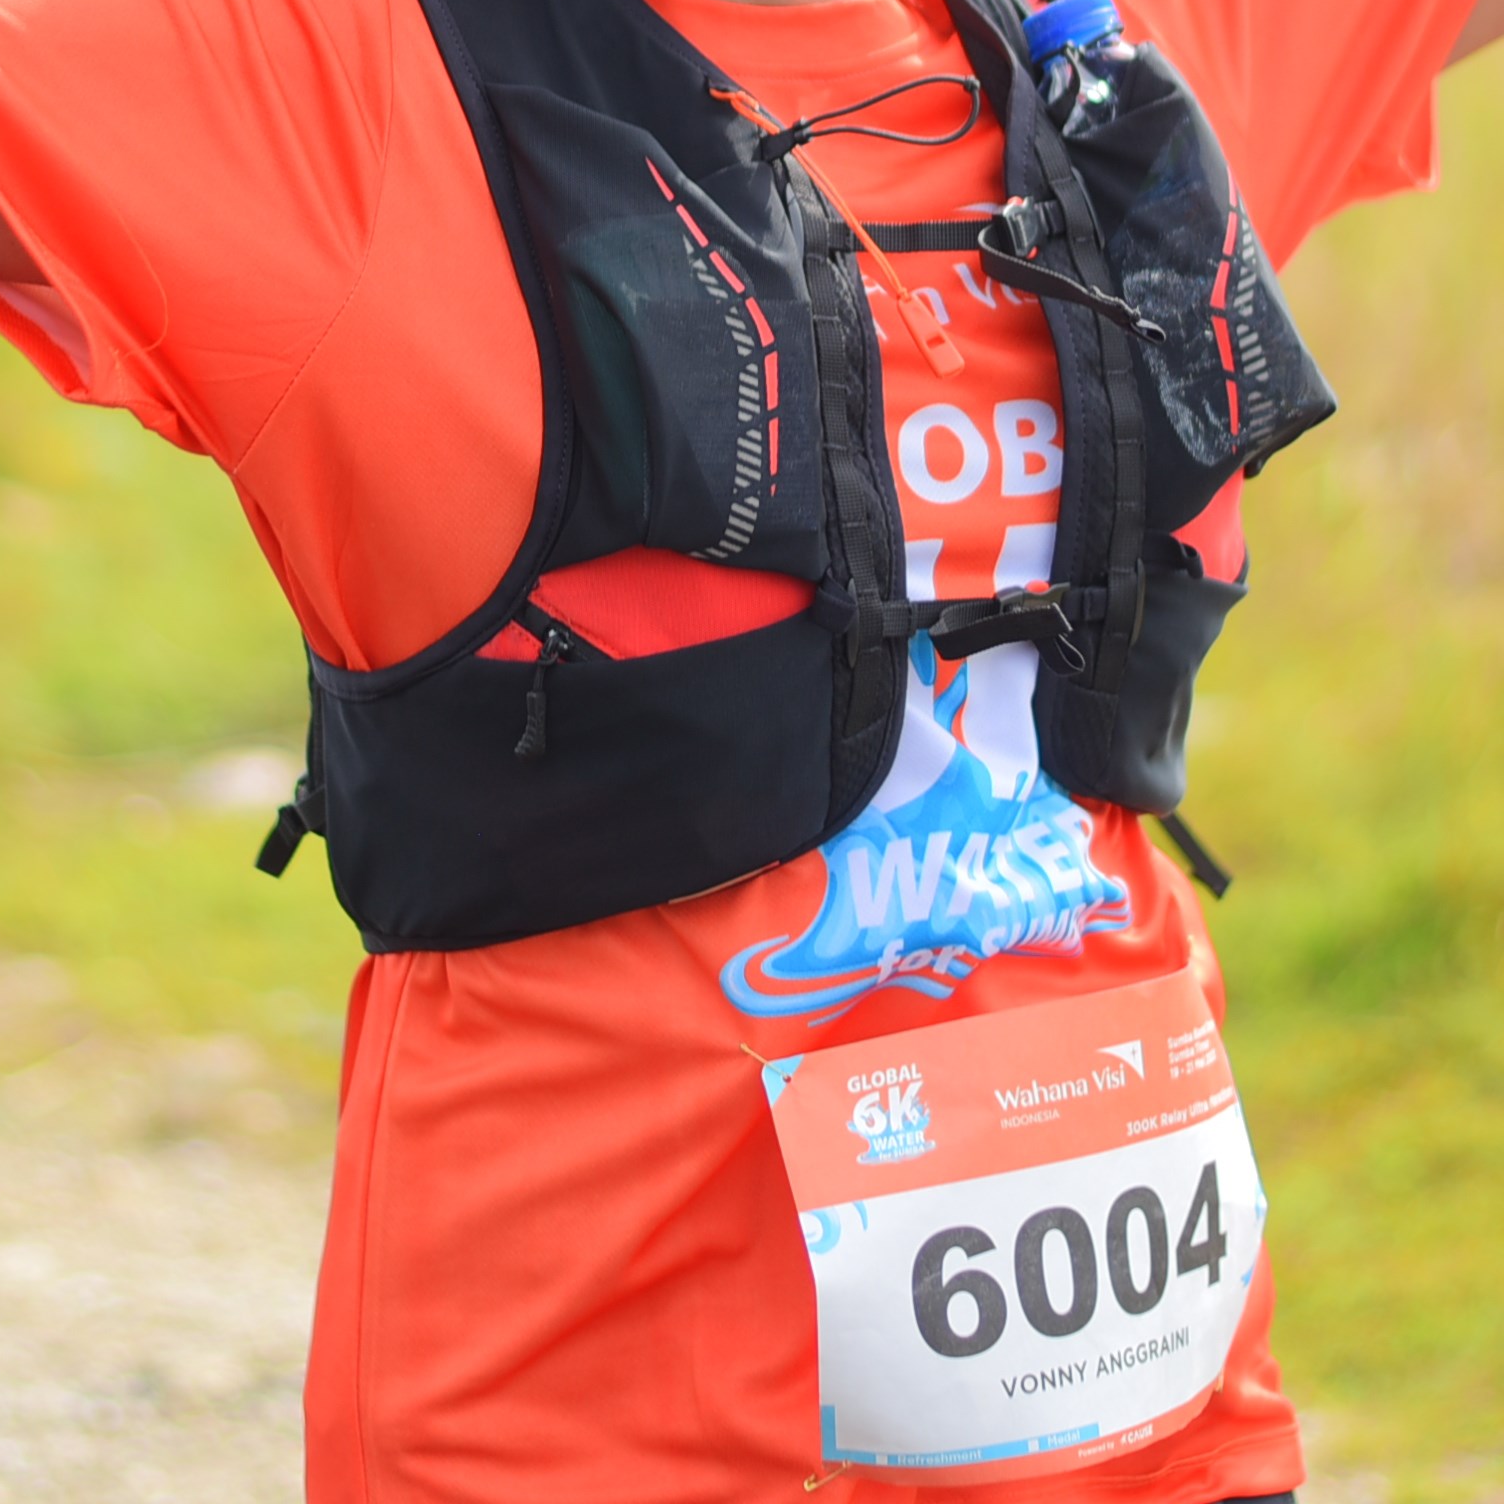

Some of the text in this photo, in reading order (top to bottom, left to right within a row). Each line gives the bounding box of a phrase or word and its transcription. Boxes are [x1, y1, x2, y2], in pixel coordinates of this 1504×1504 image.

[876, 939, 966, 984] for
[848, 1063, 922, 1093] GLOBAL
[995, 1063, 1126, 1111] Wahana Visi
[854, 1081, 923, 1135] 6K
[1000, 1107, 1061, 1129] INDONESIA
[1126, 1115, 1158, 1136] 300K
[873, 1131, 925, 1152] WATER
[912, 1160, 1227, 1358] 6004
[1001, 1325, 1190, 1399] VONNY ANGGRAINI
[1047, 1429, 1081, 1448] Medal
[897, 1449, 983, 1466] Refreshment
